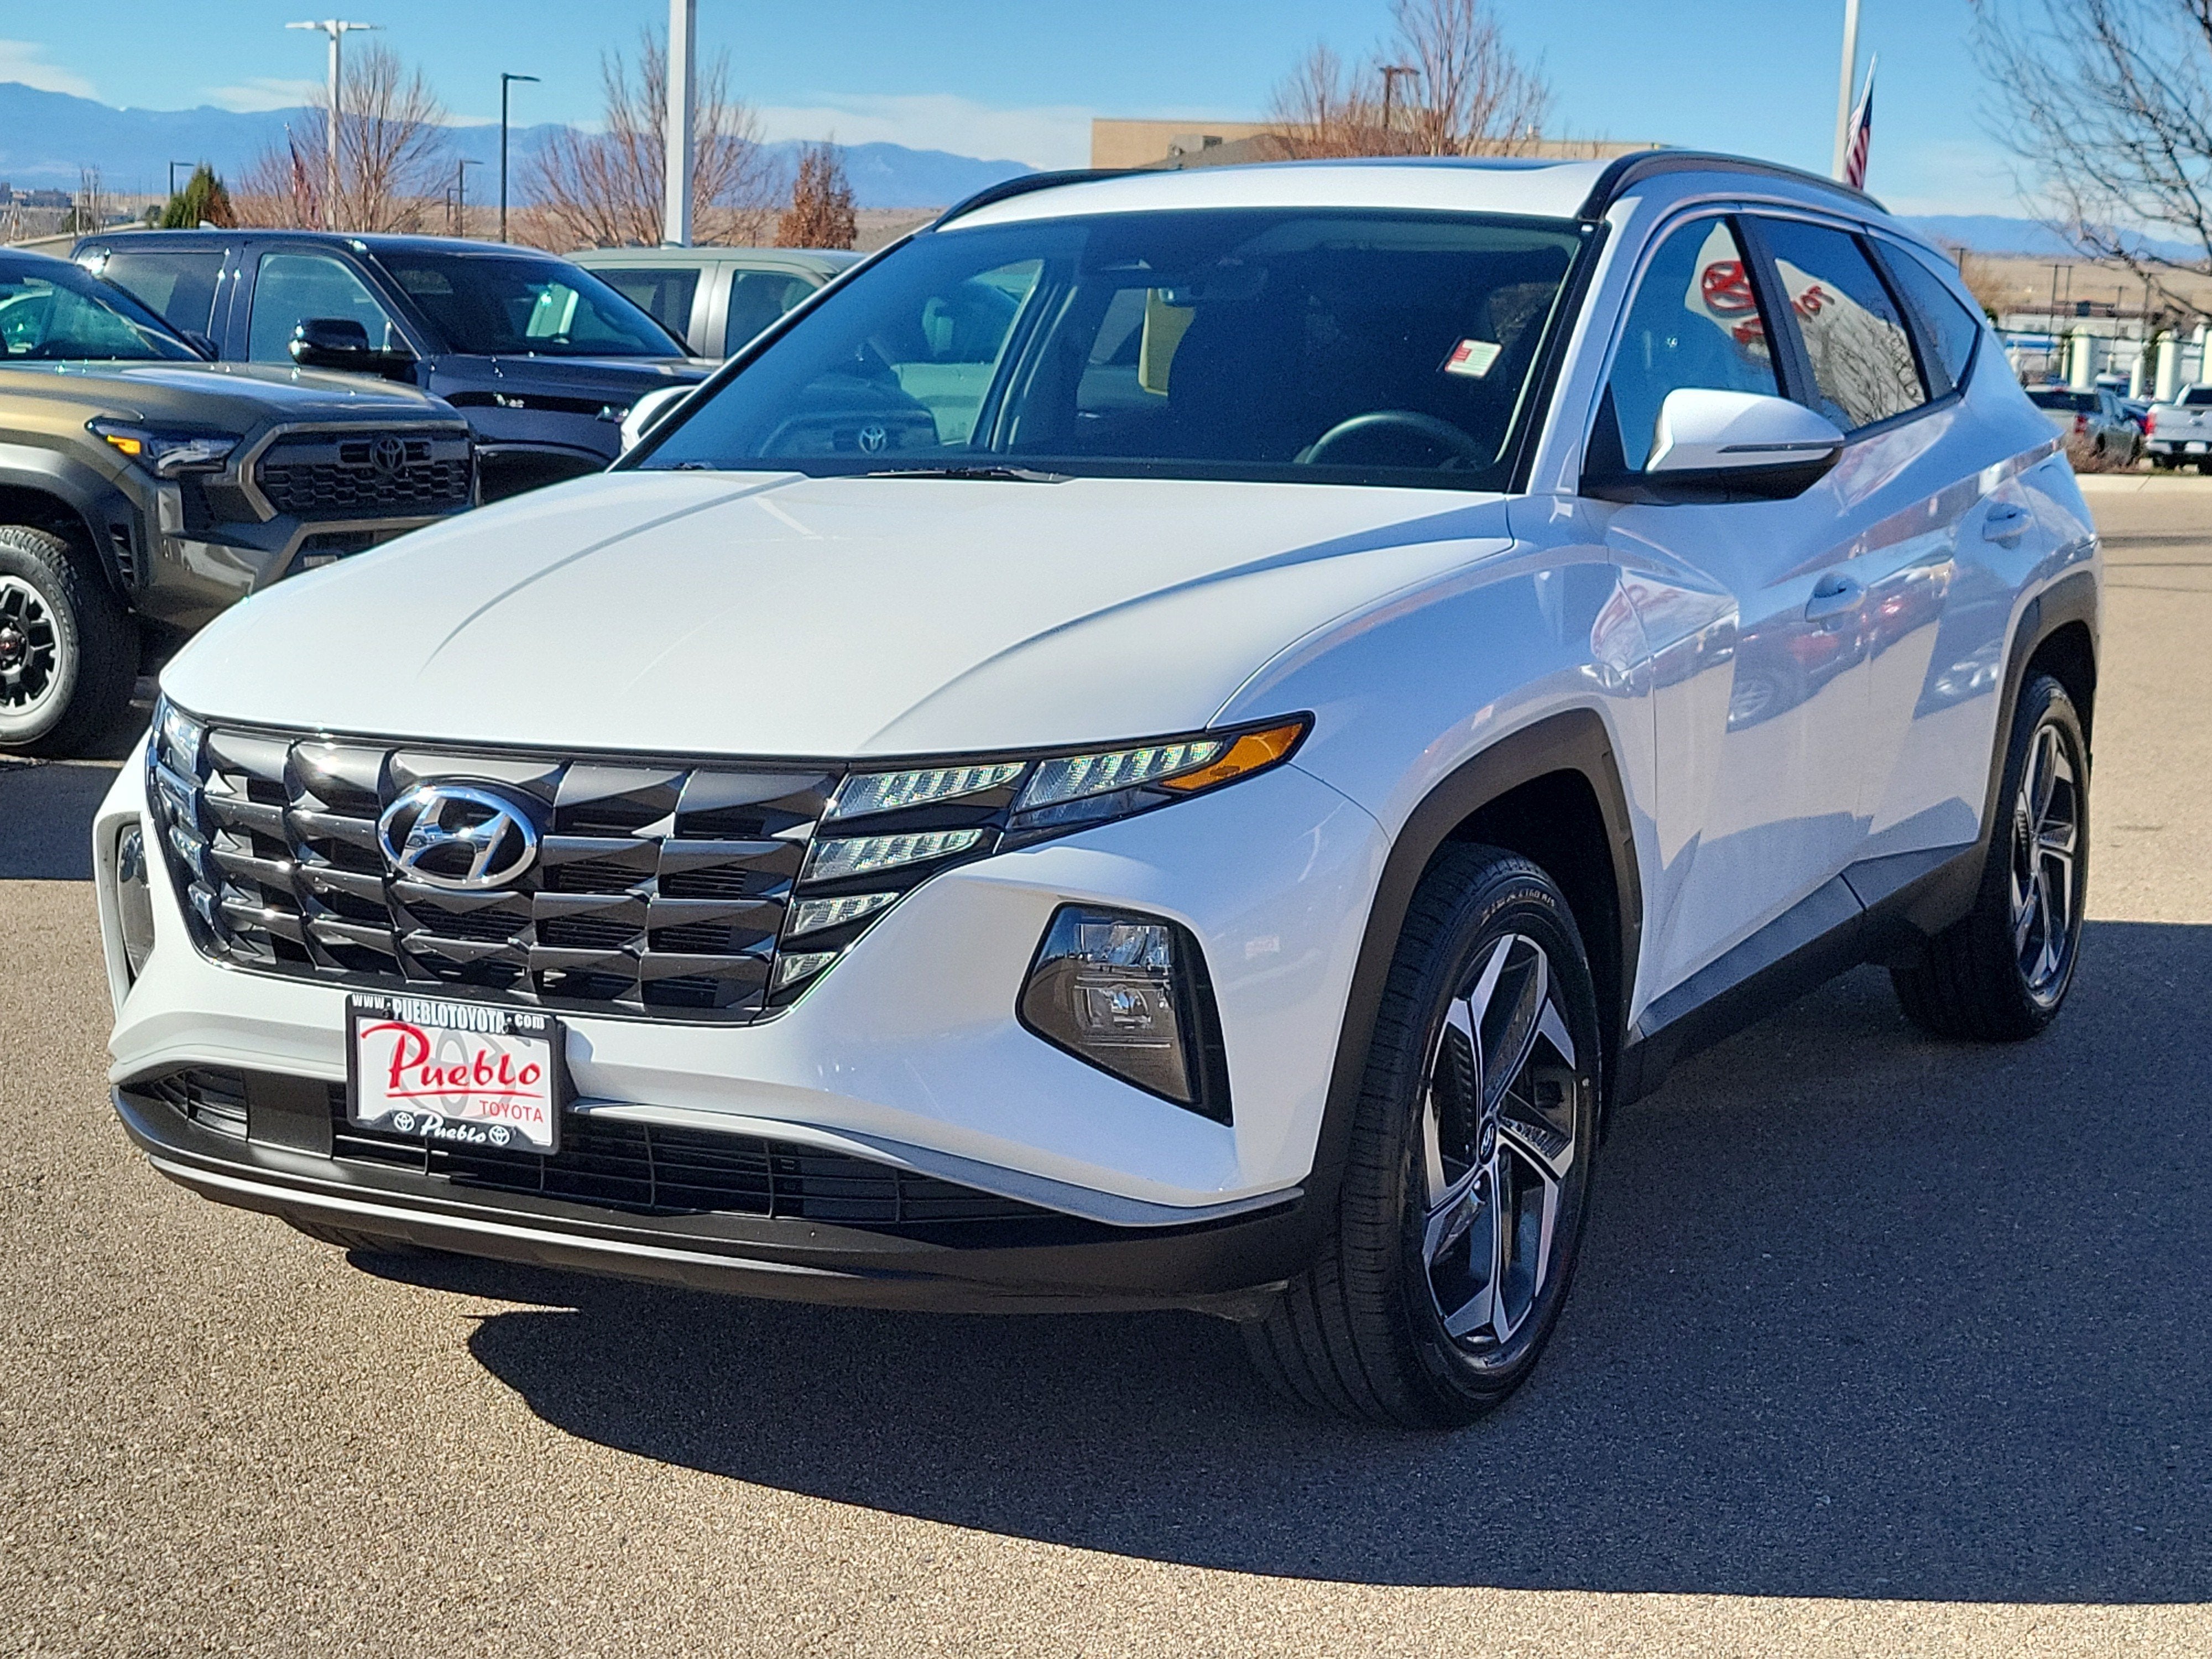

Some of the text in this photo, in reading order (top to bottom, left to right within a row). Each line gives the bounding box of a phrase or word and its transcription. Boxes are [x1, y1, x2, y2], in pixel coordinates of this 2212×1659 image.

[361, 1021, 541, 1089] Pueblo
[413, 1108, 487, 1143] Pueblo
[479, 1099, 544, 1123] TOYOTA
